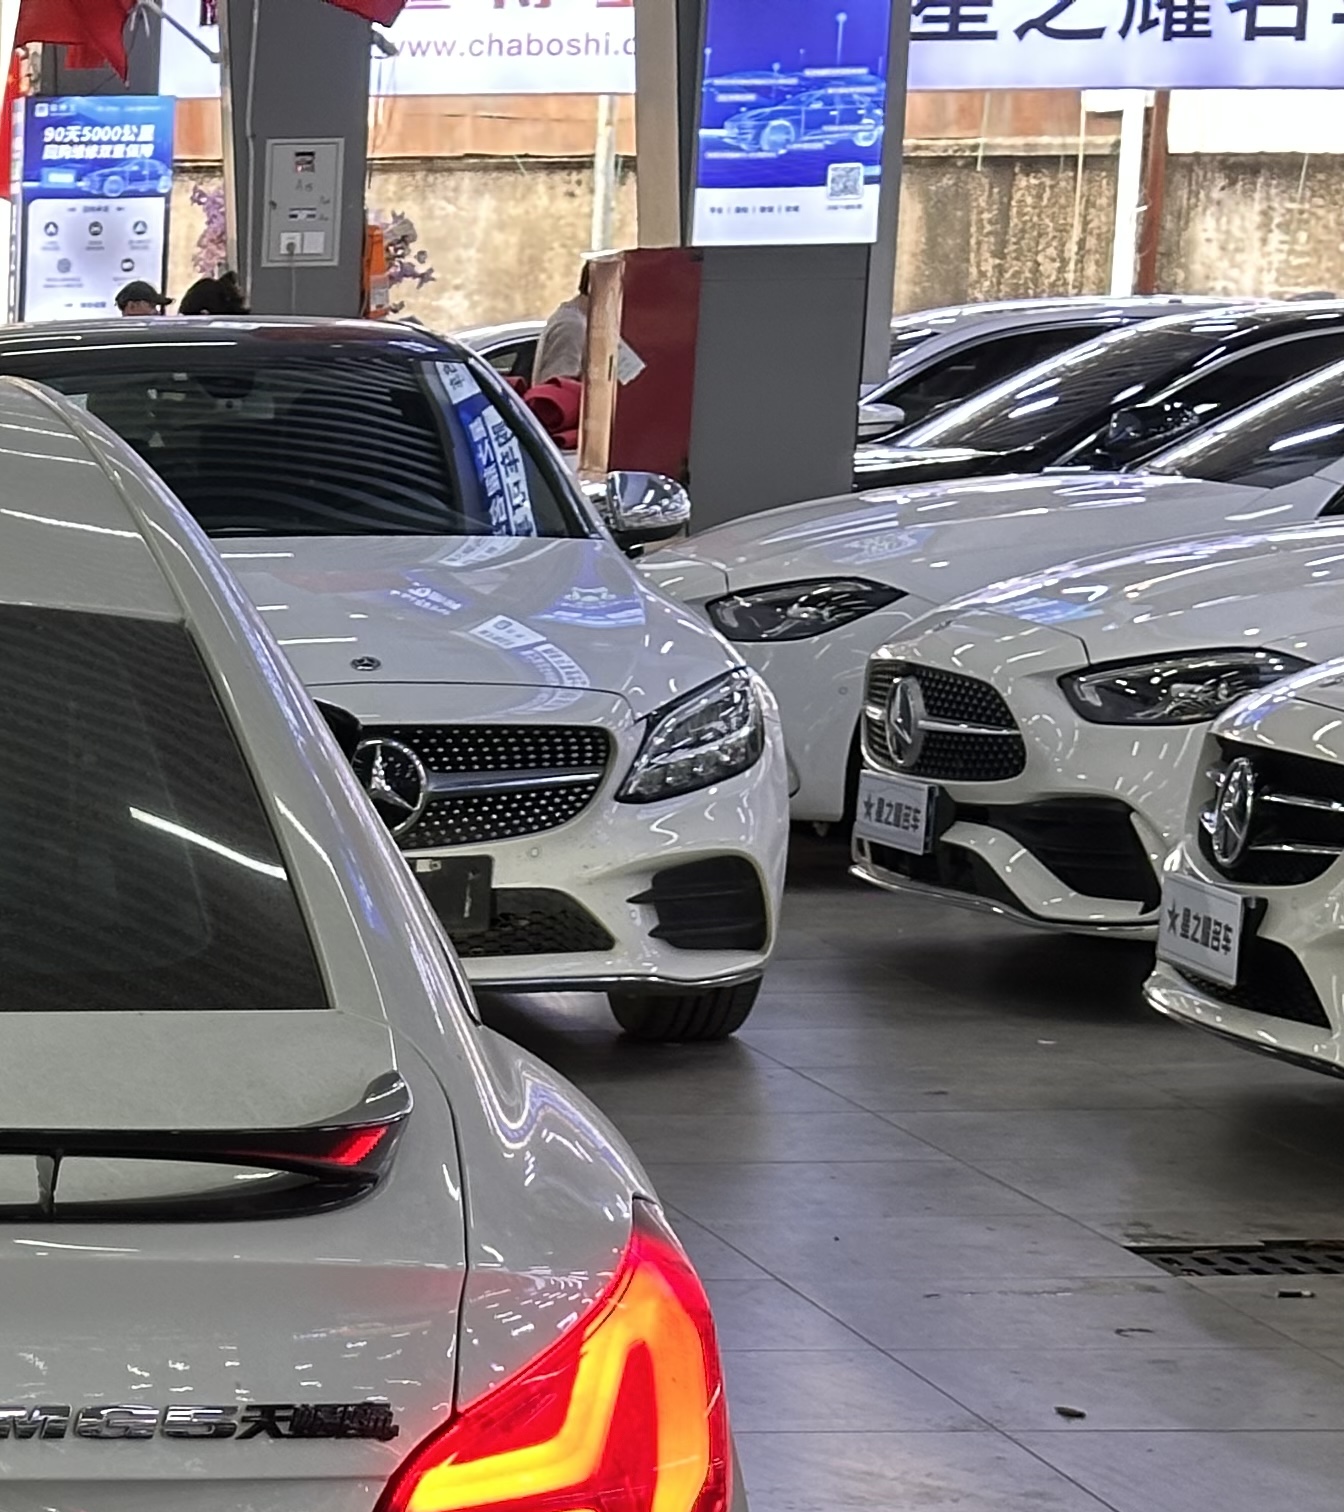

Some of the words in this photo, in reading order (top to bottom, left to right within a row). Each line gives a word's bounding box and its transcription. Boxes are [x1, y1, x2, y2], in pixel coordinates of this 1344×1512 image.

[1179, 906, 1234, 956] 星之耀名车
